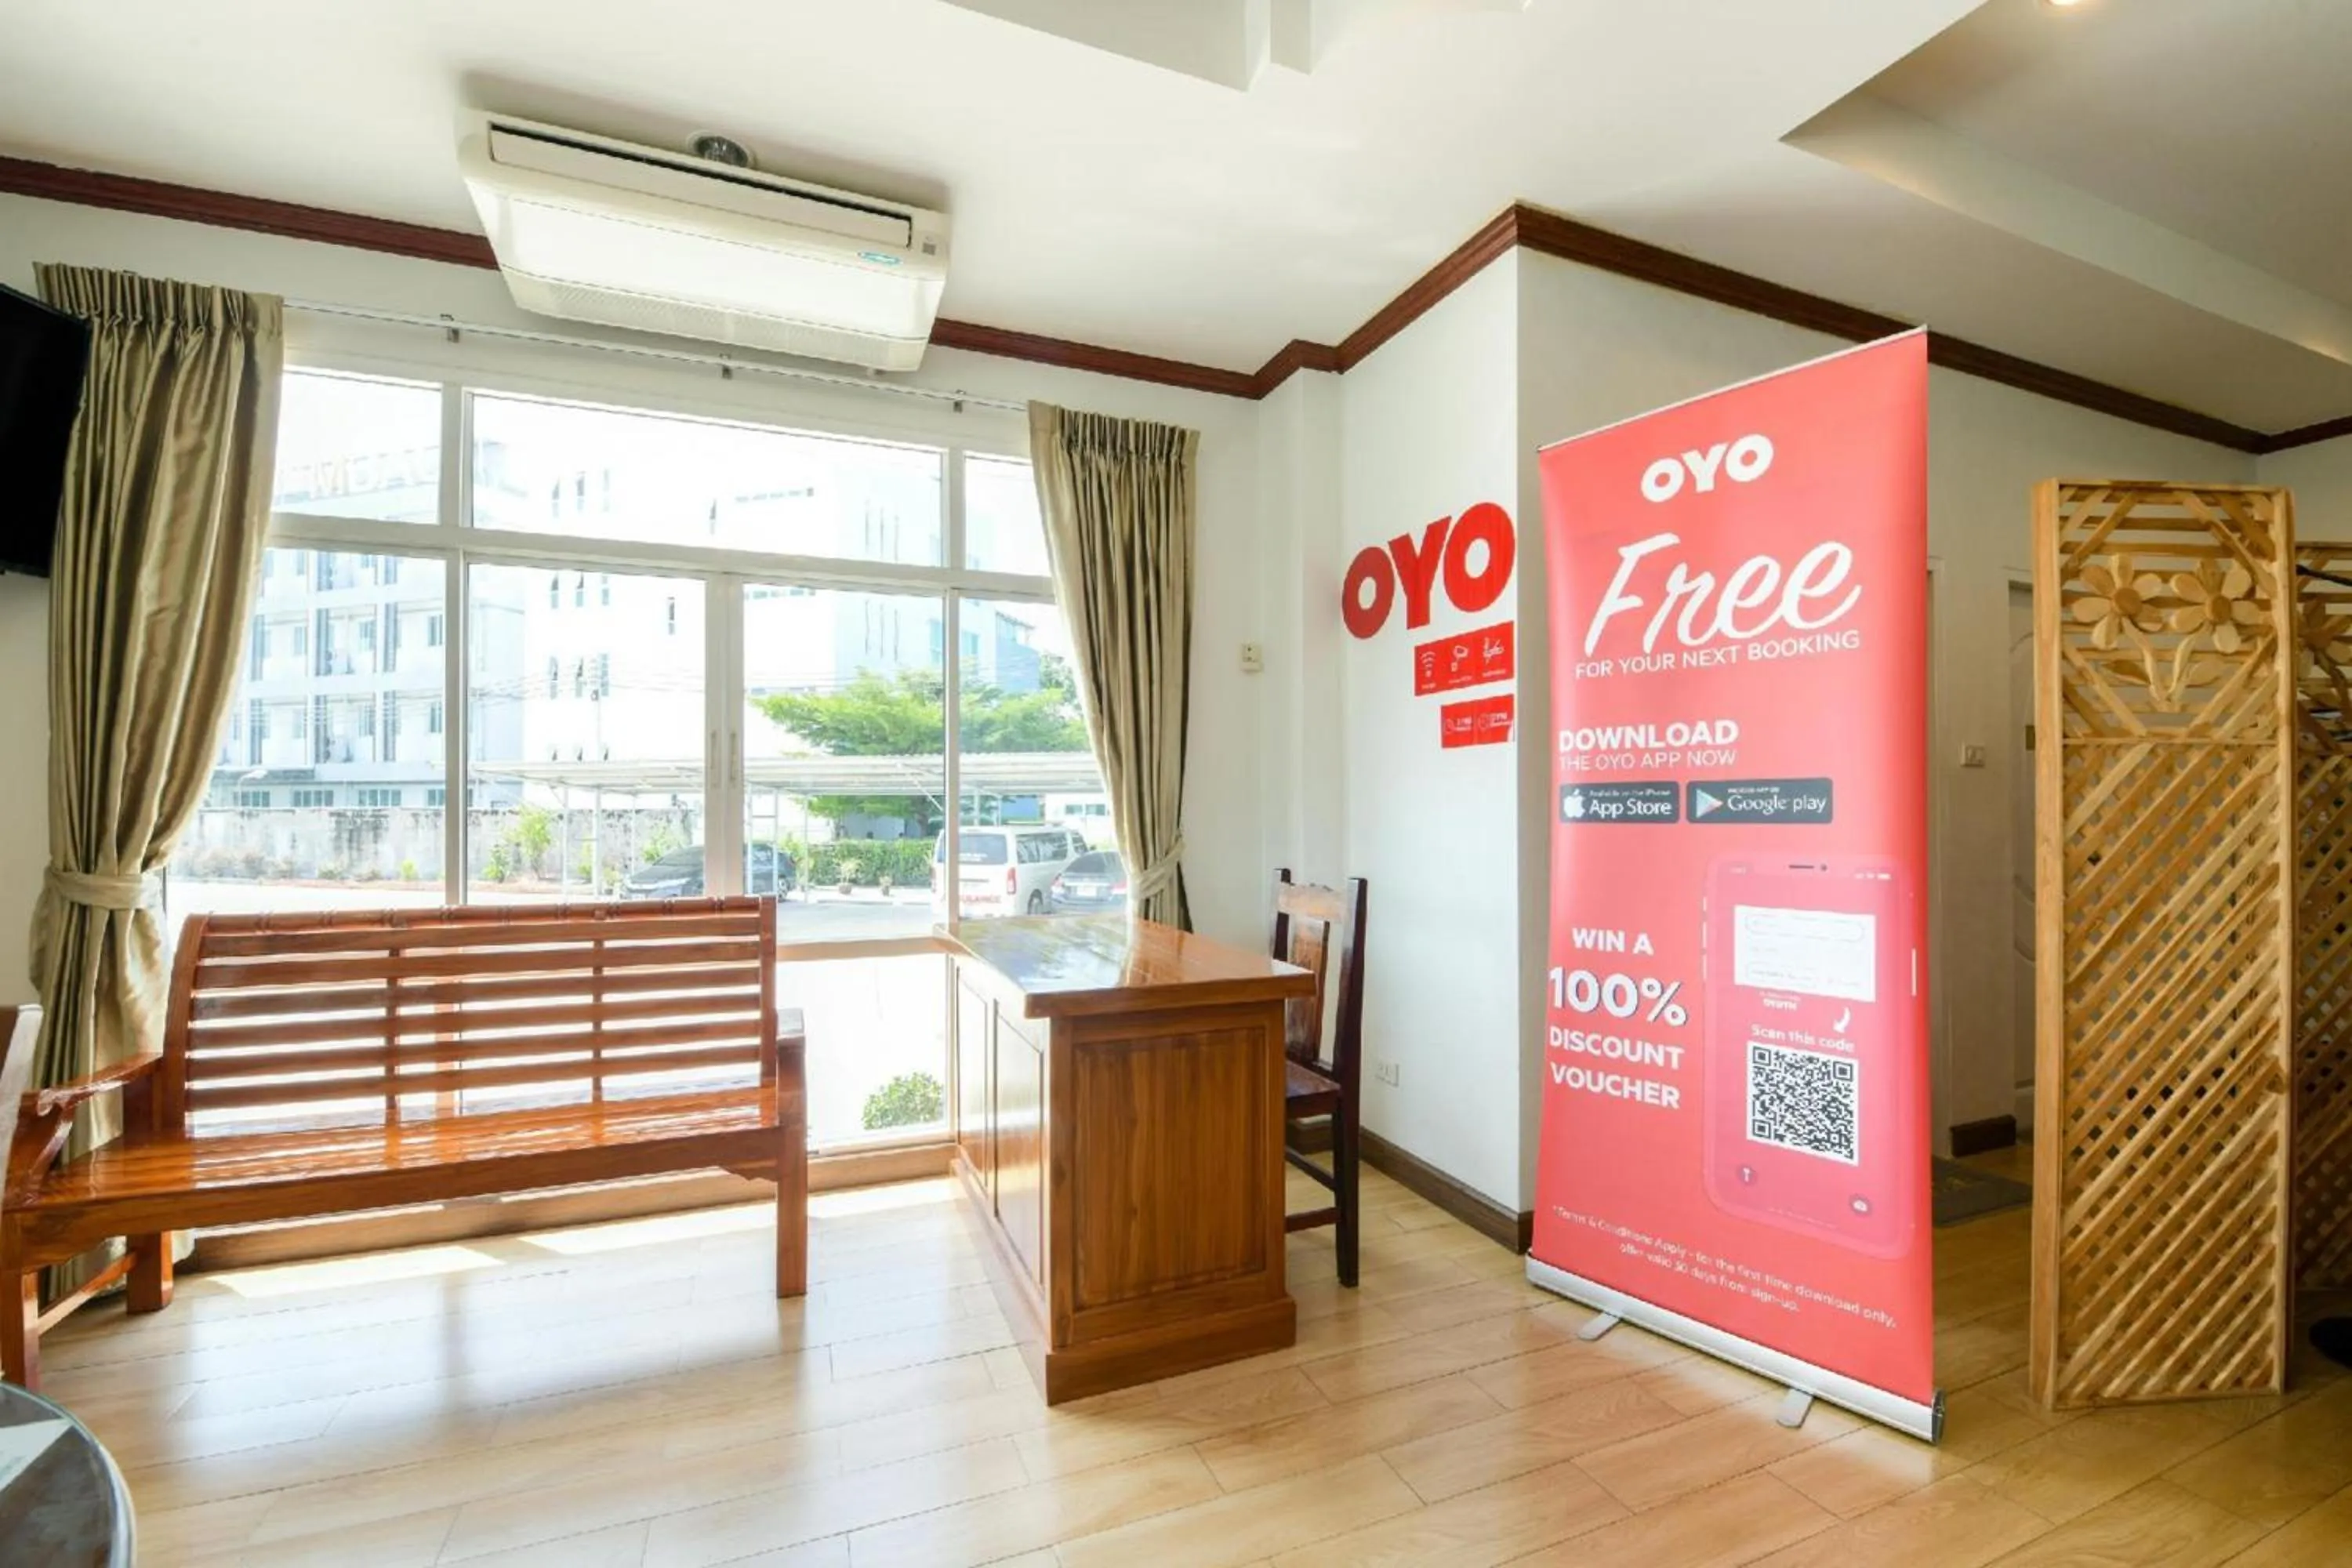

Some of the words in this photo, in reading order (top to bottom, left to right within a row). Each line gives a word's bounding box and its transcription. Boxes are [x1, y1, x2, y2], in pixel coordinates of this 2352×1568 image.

[1640, 434, 1774, 503] OYO
[1341, 501, 1515, 640] OYO
[1584, 532, 1862, 657] Free
[1576, 661, 1613, 679] FOR
[1619, 653, 1675, 674] YOUR
[1682, 644, 1741, 668] NEXT
[1748, 630, 1860, 661] BOOKING
[1559, 719, 1739, 753] DOWNLOAD
[1559, 755, 1591, 771] THE
[1595, 753, 1635, 770] OYO
[1640, 752, 1681, 768] APP
[1687, 750, 1737, 766] NOW
[1588, 799, 1624, 819] App
[1627, 797, 1672, 815] Store
[1727, 793, 1788, 816] Google
[1792, 794, 1828, 814] play
[1573, 927, 1624, 952] WIN
[1632, 933, 1654, 956] A
[1549, 967, 1688, 1027] 100%
[1550, 1026, 1685, 1070] DISCOUNT
[1751, 1022, 1786, 1041] Scan
[1788, 1029, 1816, 1046] this
[1819, 1036, 1855, 1054] code
[1551, 1062, 1680, 1109] VOUCHER
[1654, 1237, 1686, 1259] Apply
[1795, 1285, 1860, 1315] download
